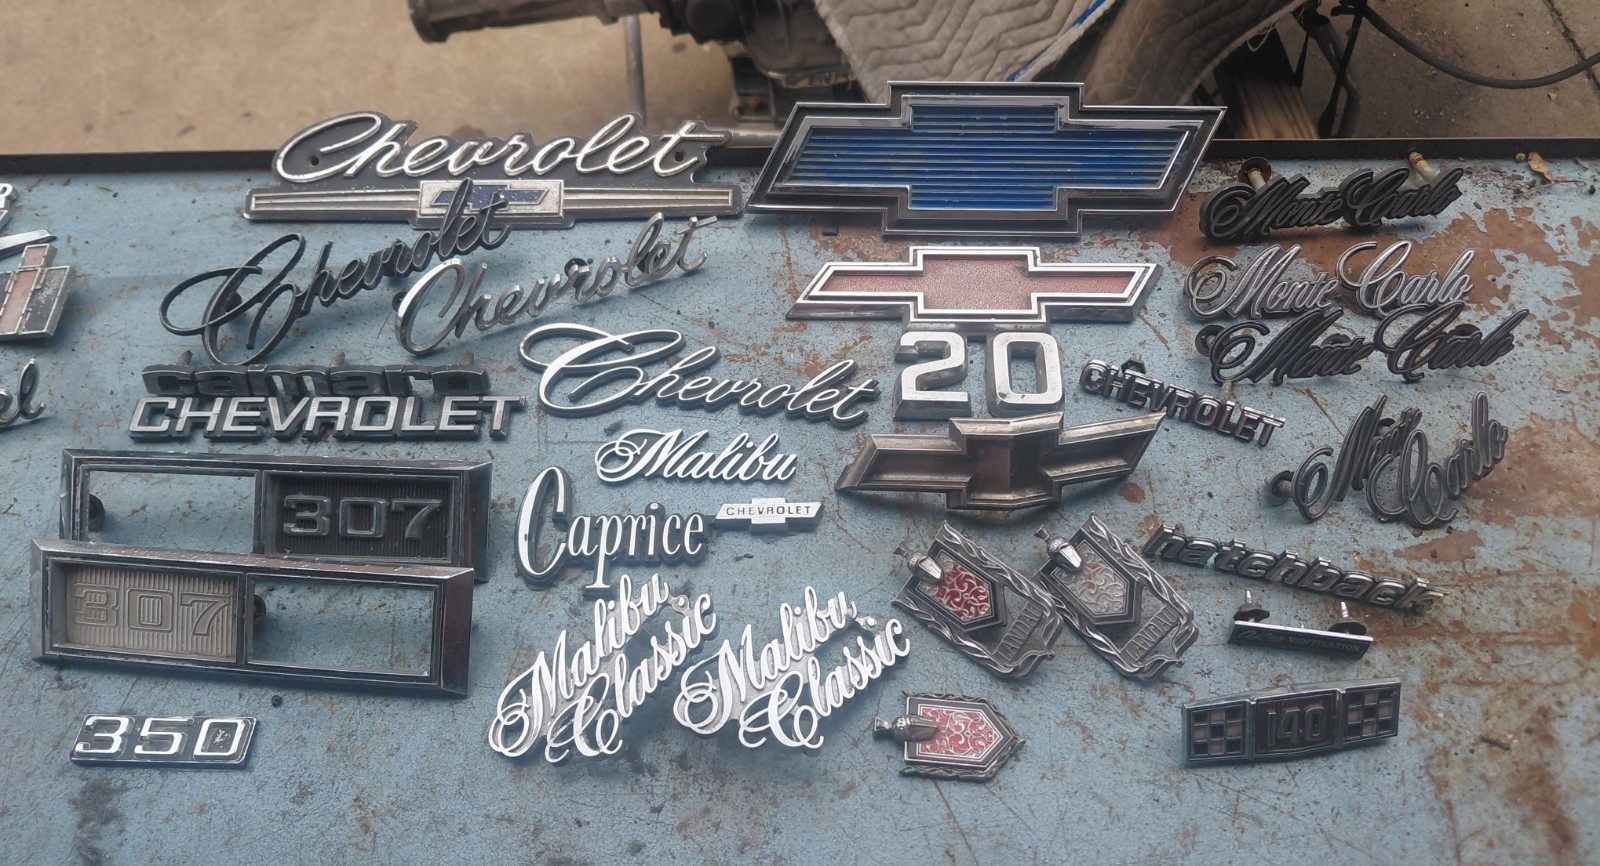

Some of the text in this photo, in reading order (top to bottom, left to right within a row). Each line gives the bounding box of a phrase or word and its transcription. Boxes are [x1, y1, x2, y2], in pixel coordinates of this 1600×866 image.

[275, 112, 723, 182] Chevrolet
[159, 178, 512, 366] Chevrolet
[395, 212, 716, 355] Chevrolet
[1184, 239, 1476, 320] Monte Carlo
[142, 364, 492, 396] camaro
[519, 322, 880, 421] Chevrolet
[899, 332, 1062, 408] 20
[1080, 360, 1286, 446] CHEVROLET
[129, 395, 525, 440] CHEVROLET
[594, 428, 798, 483] Malibu
[283, 495, 443, 541] 307
[517, 466, 705, 589] Caprice
[724, 505, 813, 517] CHEVROLET
[1142, 524, 1448, 614] hatchback
[74, 583, 230, 636] 307
[1000, 605, 1042, 662] LANDAU
[1125, 608, 1179, 662] LANDAU
[1288, 636, 1360, 651] VENTILATION
[489, 573, 669, 757] Malibu
[545, 593, 717, 763] Classic
[673, 585, 856, 734] Malibu
[739, 618, 911, 750] Classic
[75, 716, 247, 756] 350
[1267, 703, 1327, 747] 140
